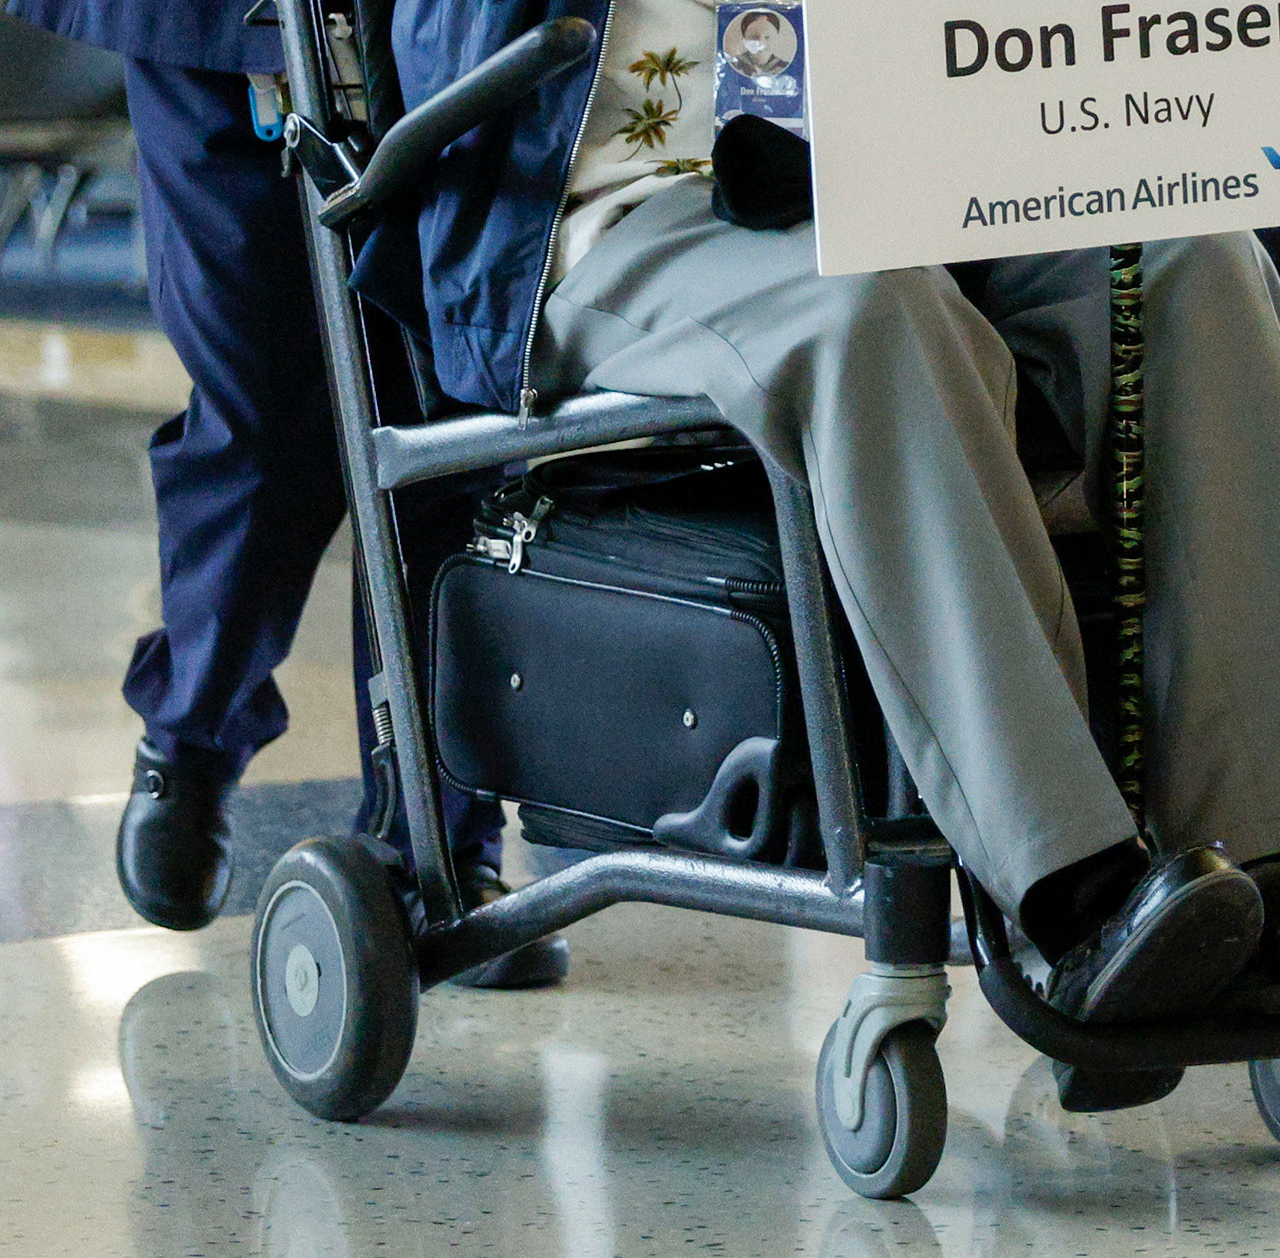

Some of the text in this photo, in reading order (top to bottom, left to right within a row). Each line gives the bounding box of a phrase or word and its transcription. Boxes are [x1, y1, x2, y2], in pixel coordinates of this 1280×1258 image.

[943, 18, 1076, 78] Don
[1040, 91, 1215, 135] U.S. Navy
[962, 172, 1259, 229] American Airlines
